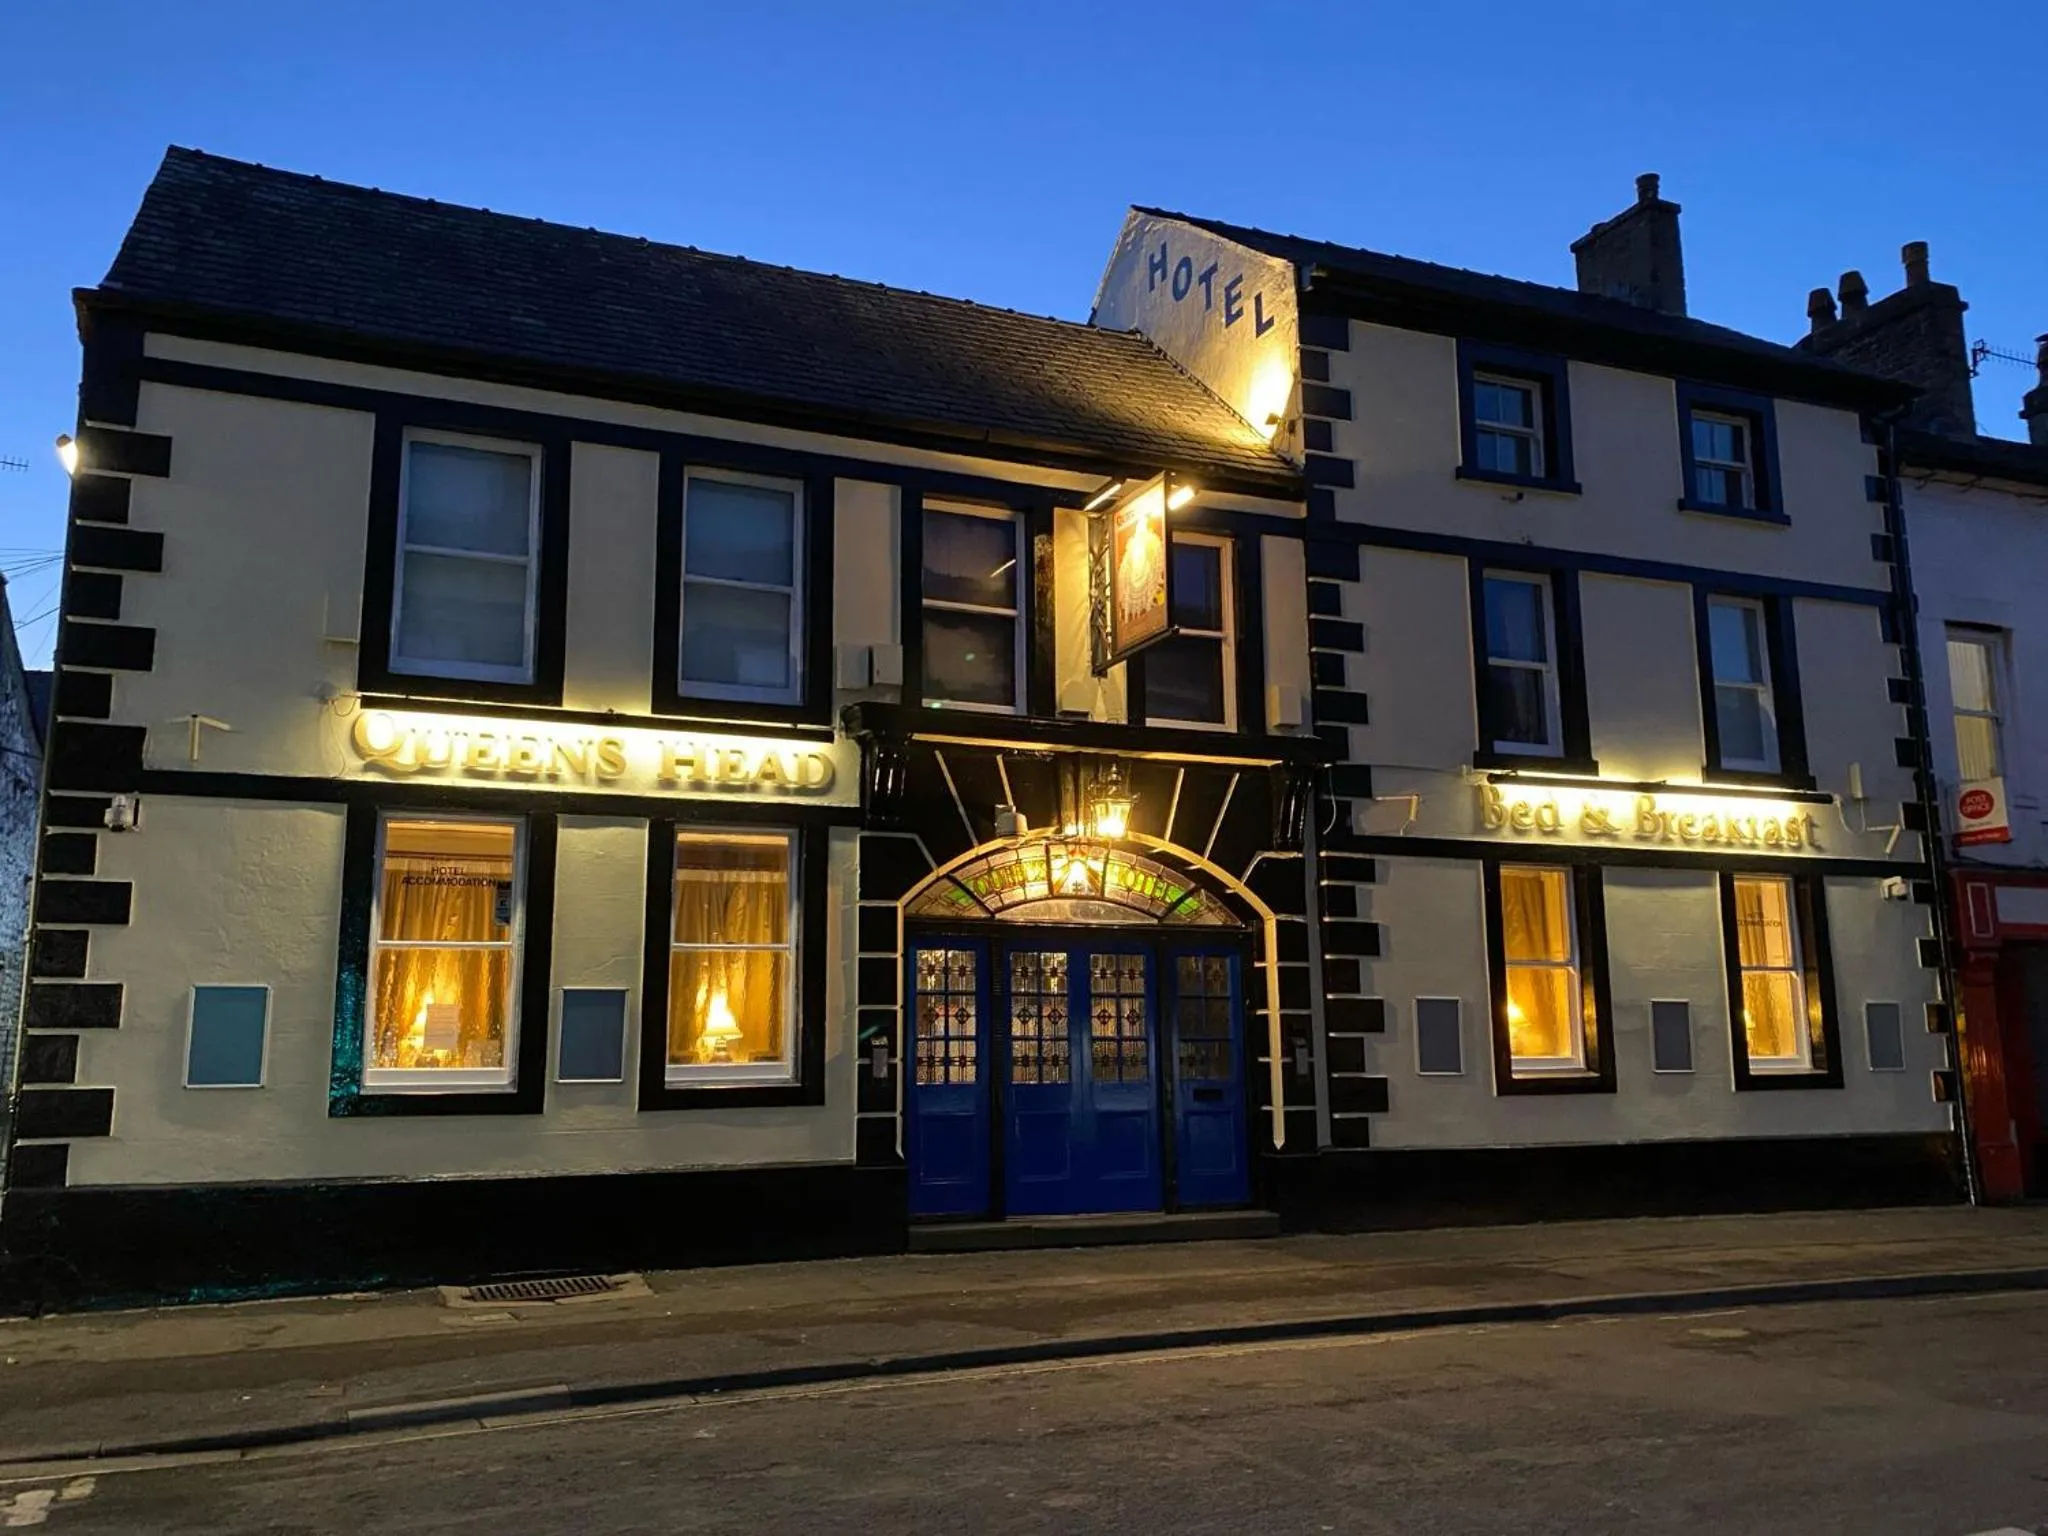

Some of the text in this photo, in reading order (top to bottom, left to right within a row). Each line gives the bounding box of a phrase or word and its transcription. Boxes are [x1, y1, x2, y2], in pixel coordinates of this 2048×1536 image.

[1149, 241, 1274, 338] HOTEL
[656, 739, 835, 787] HEAD
[1477, 784, 1564, 832] Bed
[1580, 797, 1623, 835] &
[431, 866, 465, 876] HOTEL
